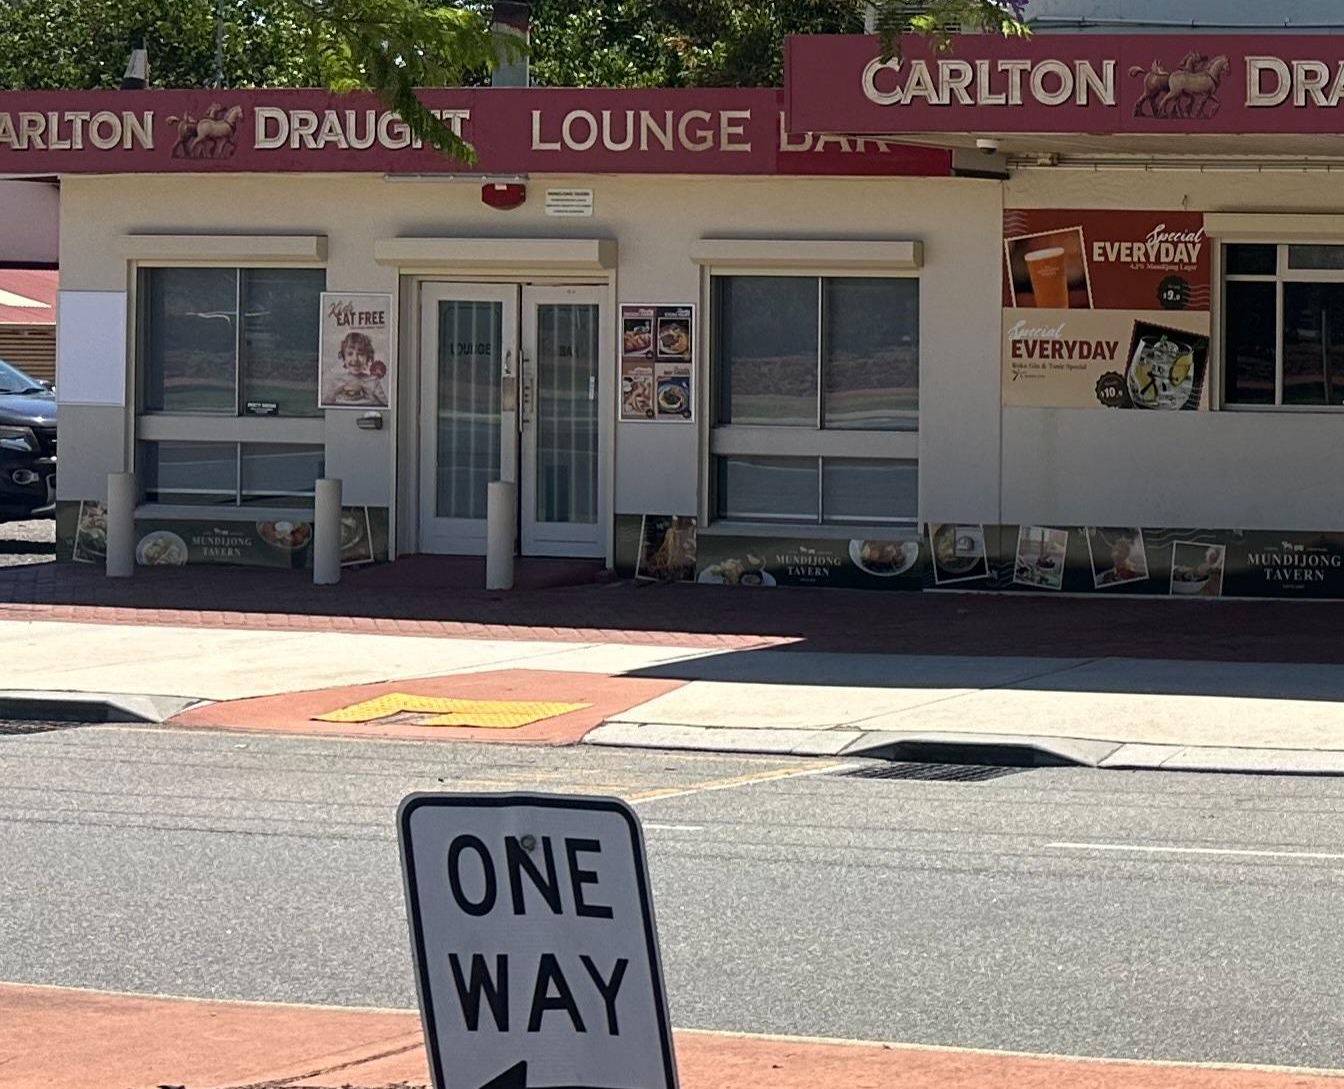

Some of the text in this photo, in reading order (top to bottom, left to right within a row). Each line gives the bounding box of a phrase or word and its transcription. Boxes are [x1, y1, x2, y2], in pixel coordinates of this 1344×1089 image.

[861, 56, 1116, 106] CARLTON
[531, 109, 752, 152] LOUNGE
[1145, 223, 1205, 245] Special
[1092, 241, 1202, 263] EVERYDAY
[336, 311, 386, 326] EAT FREE
[1008, 319, 1066, 341] Special
[1011, 339, 1120, 360] EVERYDAY
[191, 535, 252, 547] MUNDIJONG
[201, 546, 241, 557] TAVERN
[775, 554, 841, 566] MUNDIJONG
[1247, 553, 1341, 567] MUNDIJONG
[787, 565, 830, 577] TAVERN
[1263, 568, 1325, 581] TAVERN
[448, 834, 614, 919] ONE
[448, 953, 629, 1037] WAY
